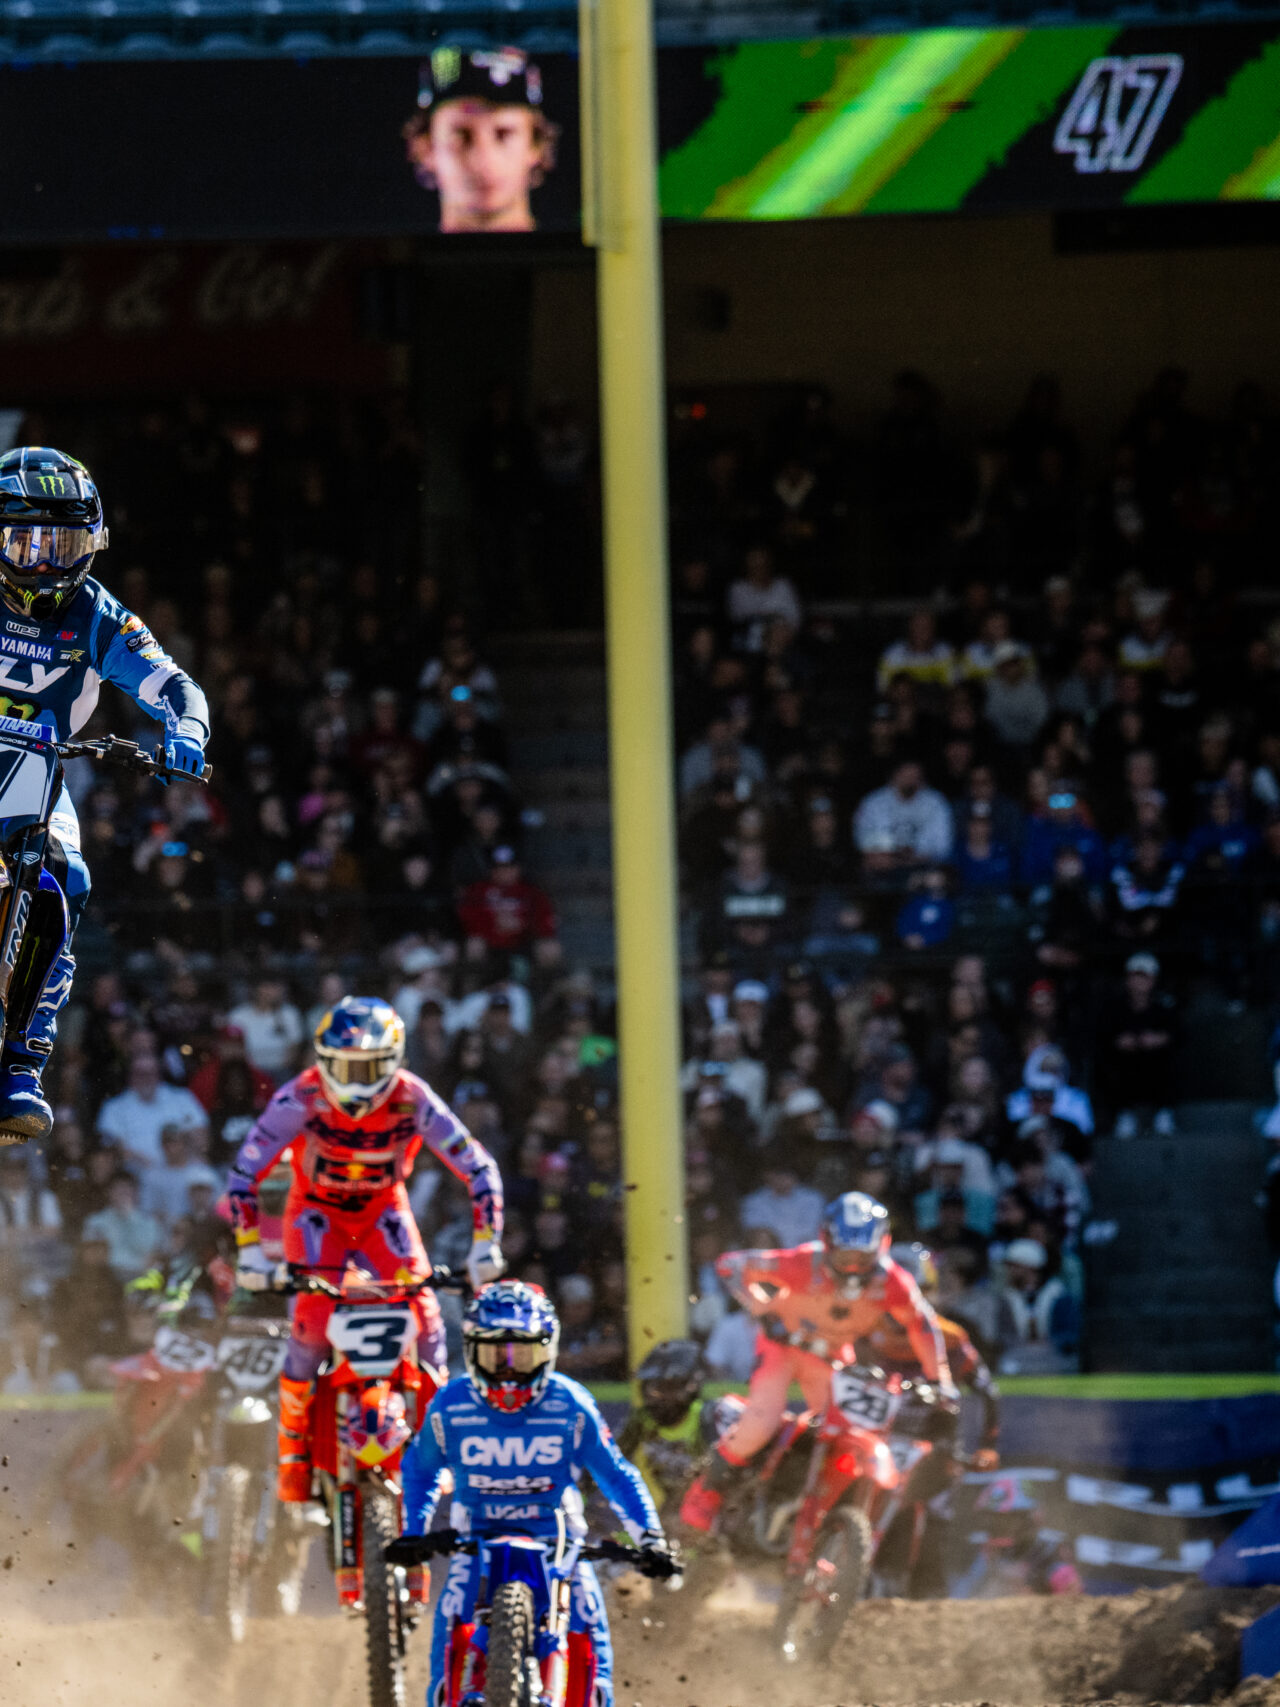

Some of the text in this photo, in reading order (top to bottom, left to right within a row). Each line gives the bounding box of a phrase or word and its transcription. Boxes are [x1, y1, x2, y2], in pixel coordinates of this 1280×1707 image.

[1053, 53, 1184, 174] 47
[101, 249, 180, 333] &
[6, 621, 41, 638] WPS
[1, 637, 53, 661] YAMAHA
[345, 1316, 407, 1362] 3
[467, 1473, 553, 1491] Beta
